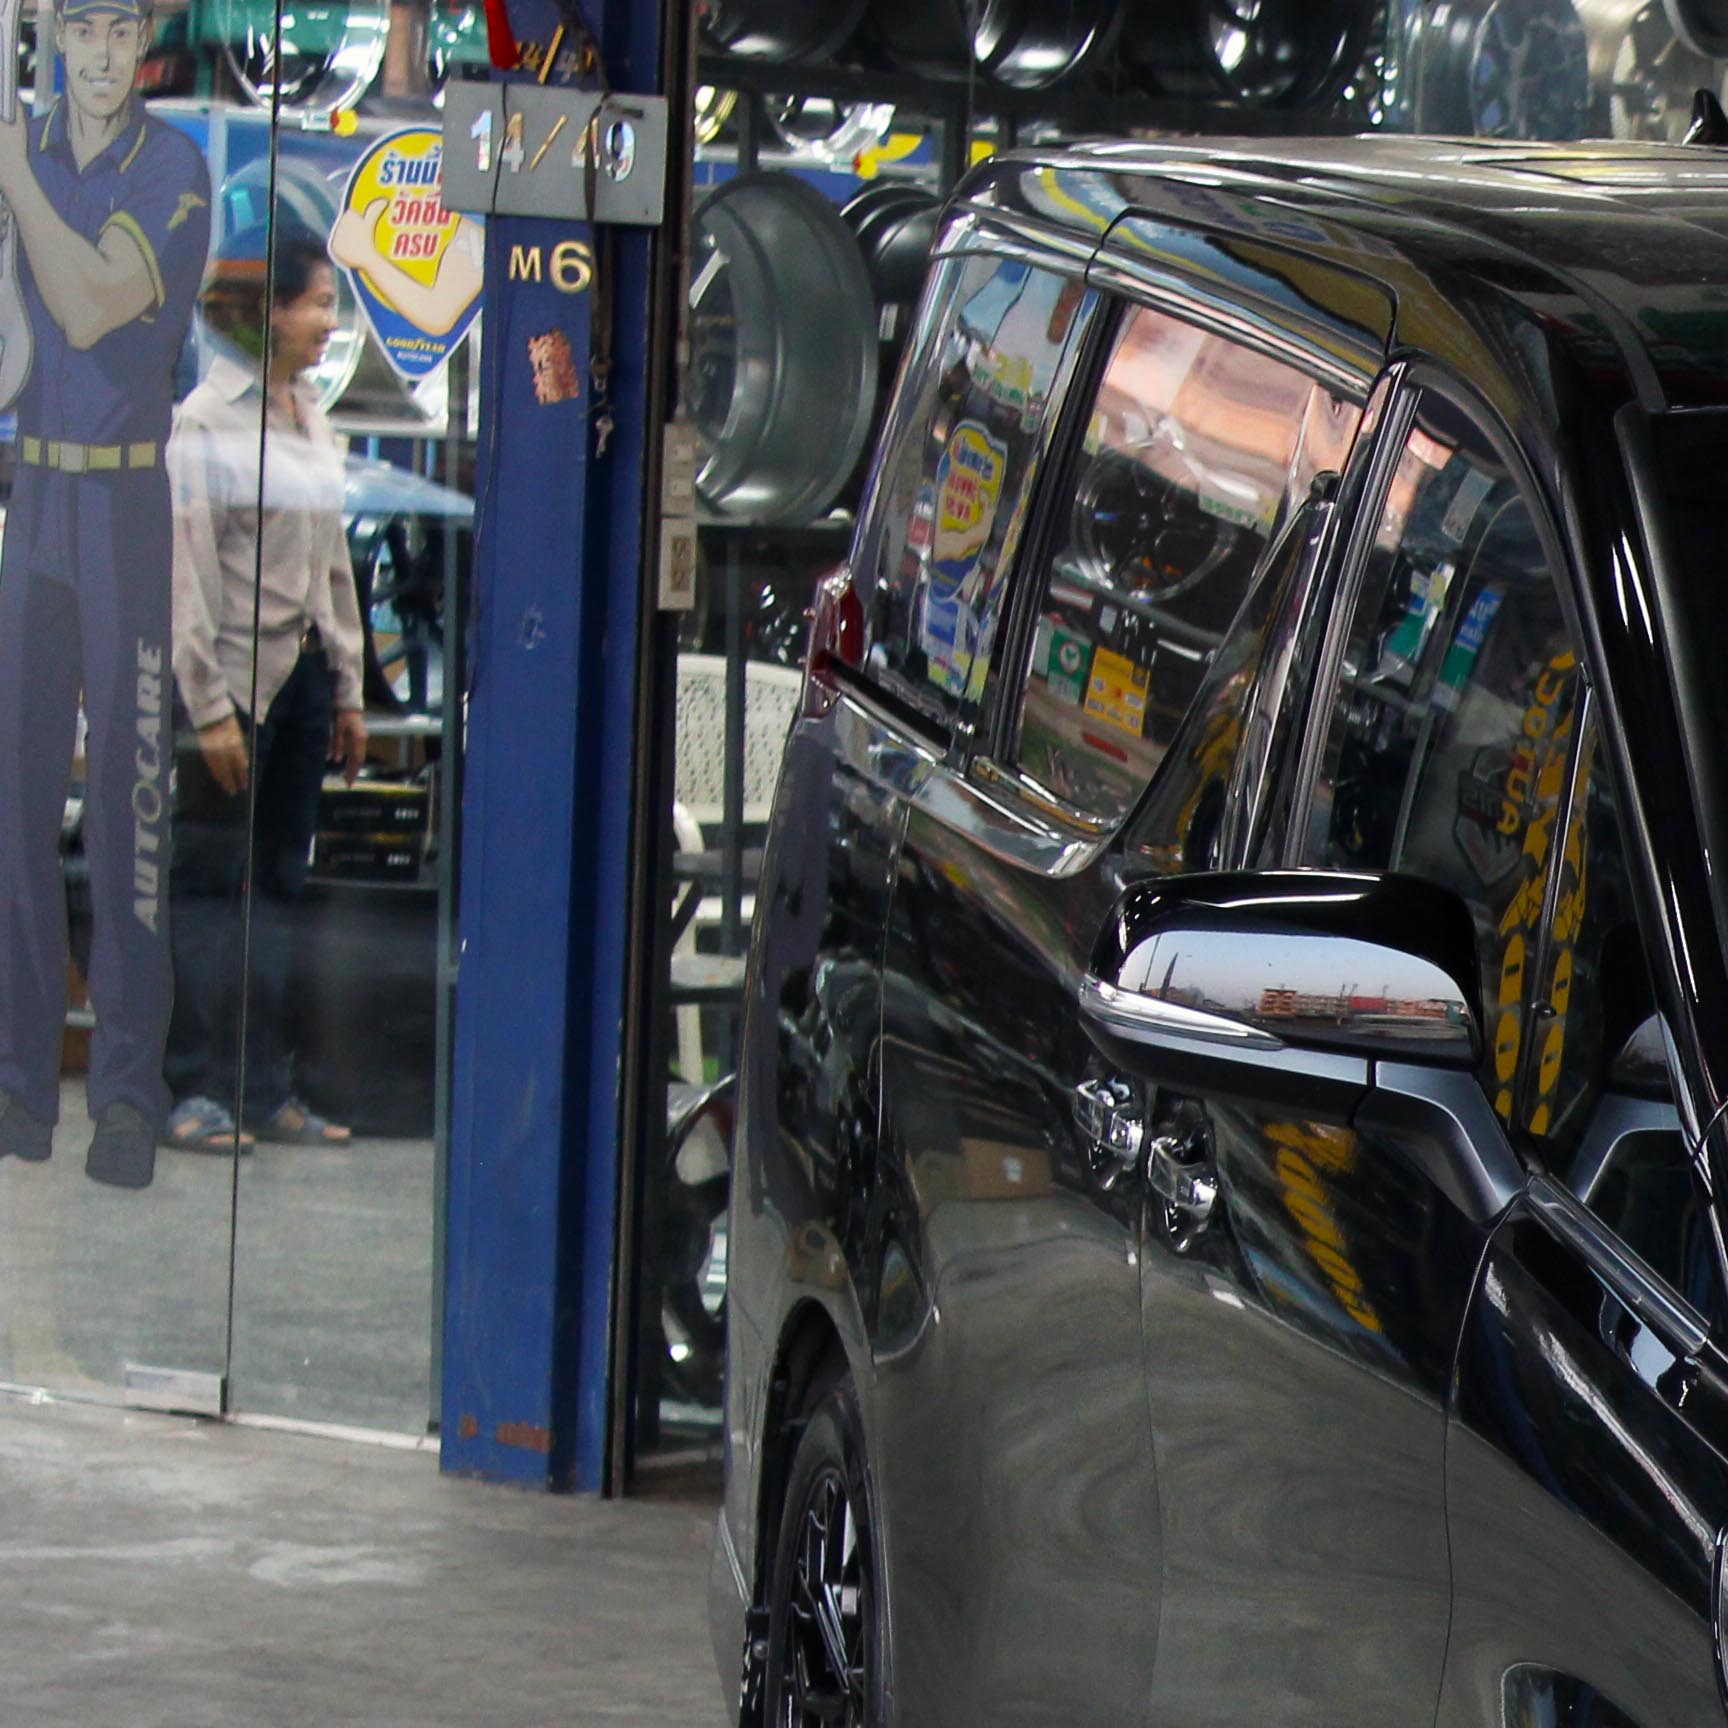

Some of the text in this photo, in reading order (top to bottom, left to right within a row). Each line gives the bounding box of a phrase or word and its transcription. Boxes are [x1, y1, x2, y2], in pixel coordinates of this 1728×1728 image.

[380, 144, 441, 186] ร้านนี้
[471, 110, 635, 182] 14/49
[132, 636, 162, 935] AUTOCARE
